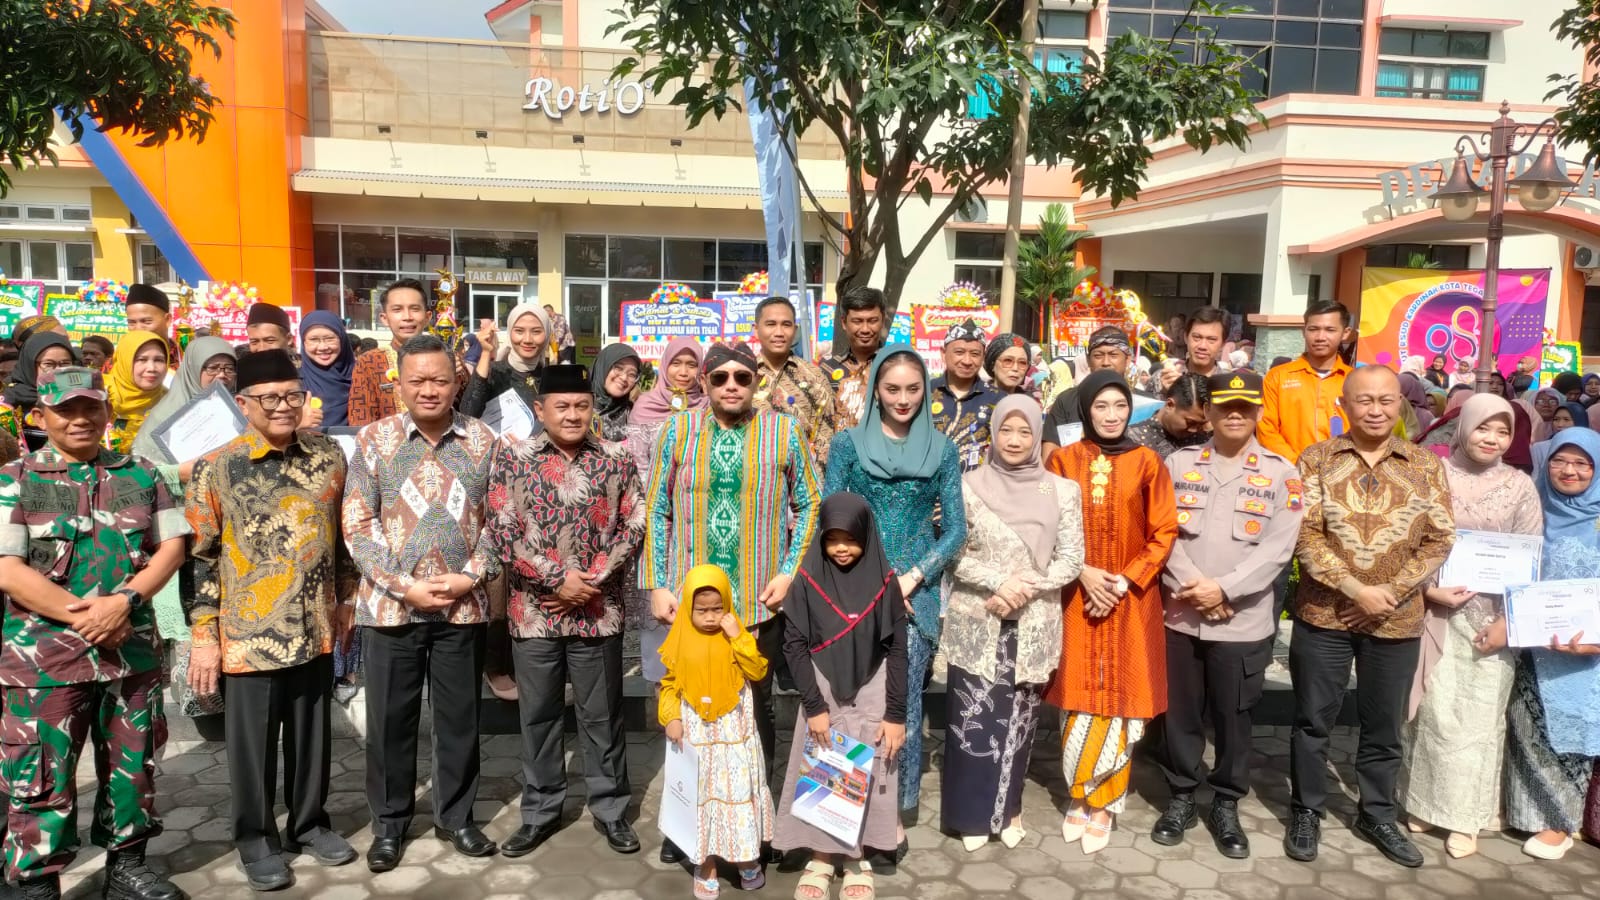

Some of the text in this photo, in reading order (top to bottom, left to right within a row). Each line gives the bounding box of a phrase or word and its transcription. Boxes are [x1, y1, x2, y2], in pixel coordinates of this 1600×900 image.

[467, 270, 525, 282] TAKE AWAY
[1440, 282, 1460, 291] KOTA
[1463, 283, 1484, 297] TEGA
[1239, 486, 1275, 500] POLRI
